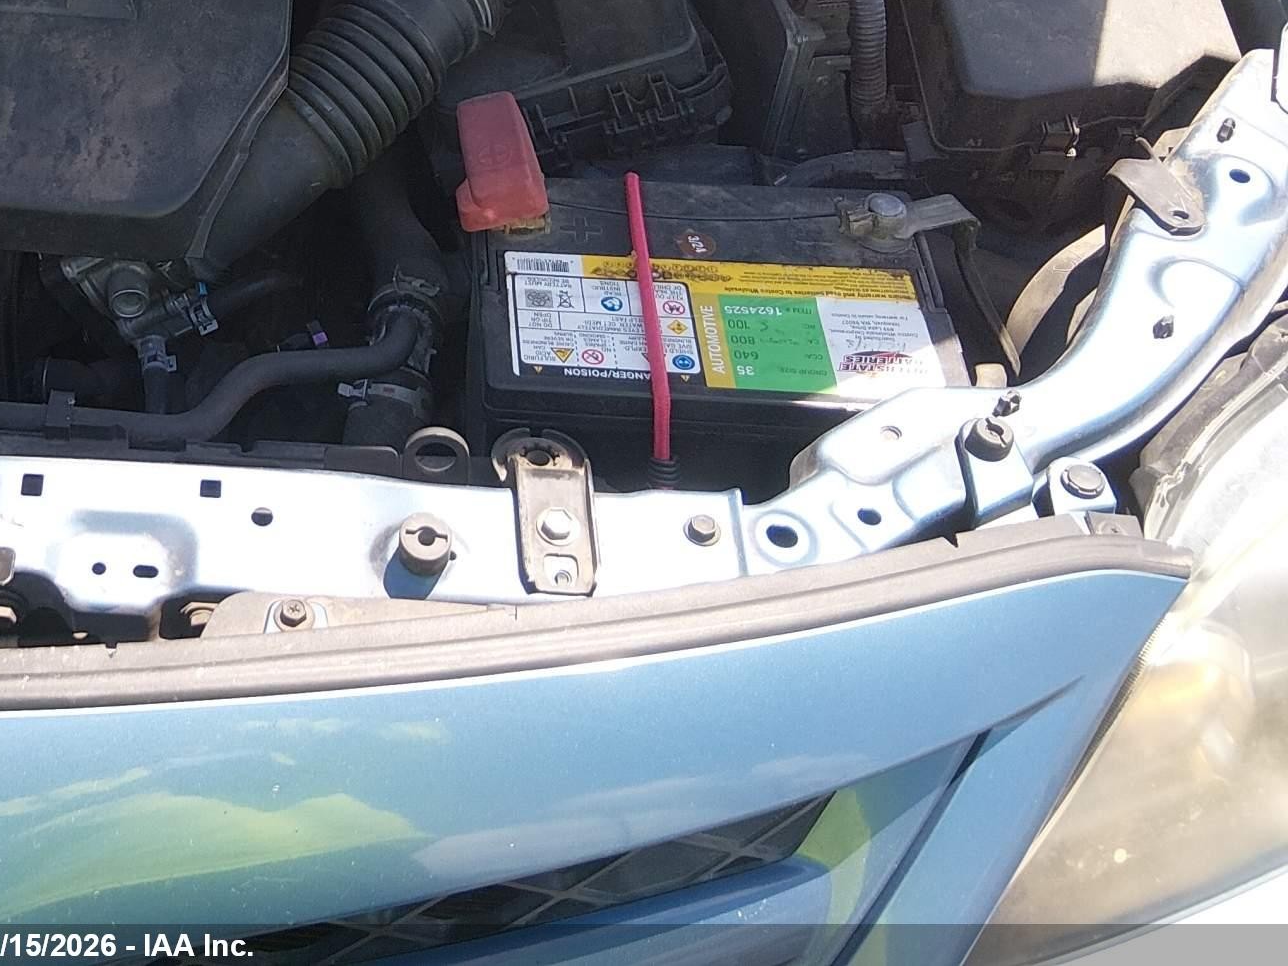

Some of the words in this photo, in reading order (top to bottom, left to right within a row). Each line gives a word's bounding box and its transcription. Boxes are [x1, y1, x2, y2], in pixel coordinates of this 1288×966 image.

[724, 305, 782, 315] 1624525
[728, 319, 751, 329] 100
[700, 305, 726, 374] AUTOMOTIVE
[730, 335, 755, 345] 800
[734, 350, 759, 360] 640
[564, 368, 650, 379] ANGER/POISON
[736, 365, 754, 375] 35
